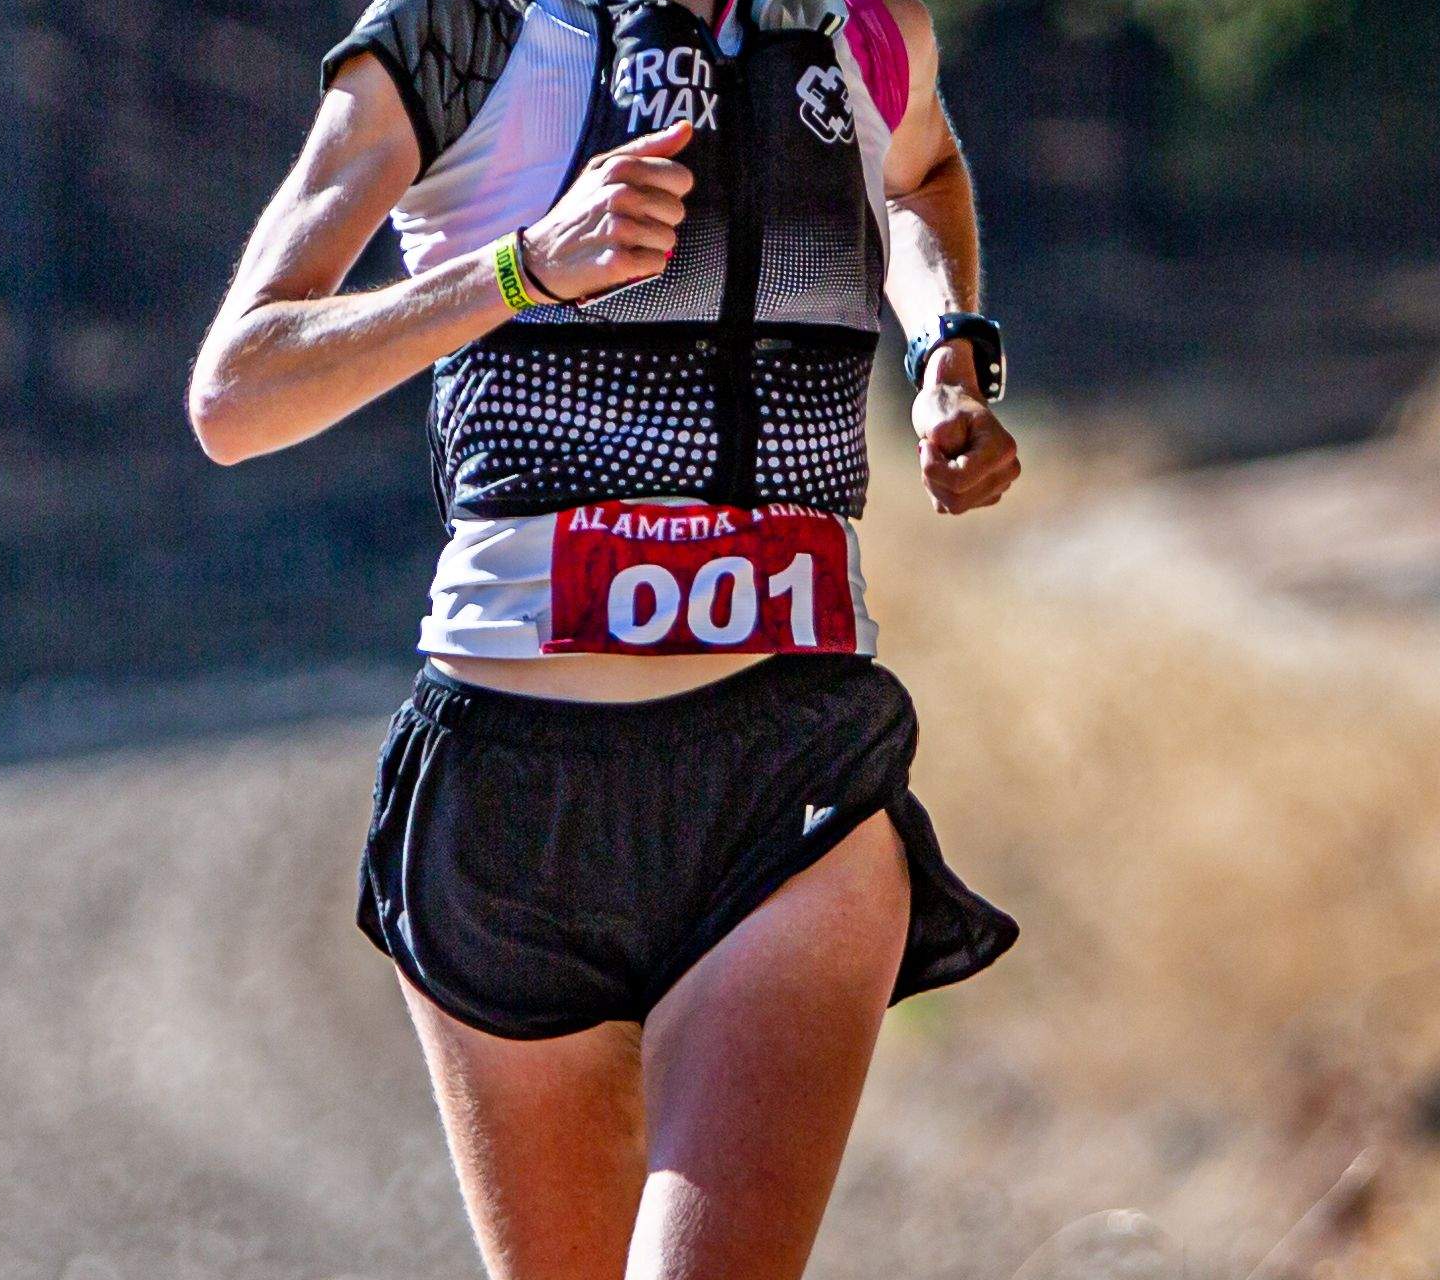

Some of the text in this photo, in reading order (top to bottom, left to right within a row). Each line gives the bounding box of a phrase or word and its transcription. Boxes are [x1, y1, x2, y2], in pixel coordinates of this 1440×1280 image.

[627, 87, 720, 134] MAX
[568, 506, 736, 541] ALAMEDA
[607, 552, 818, 647] 001
